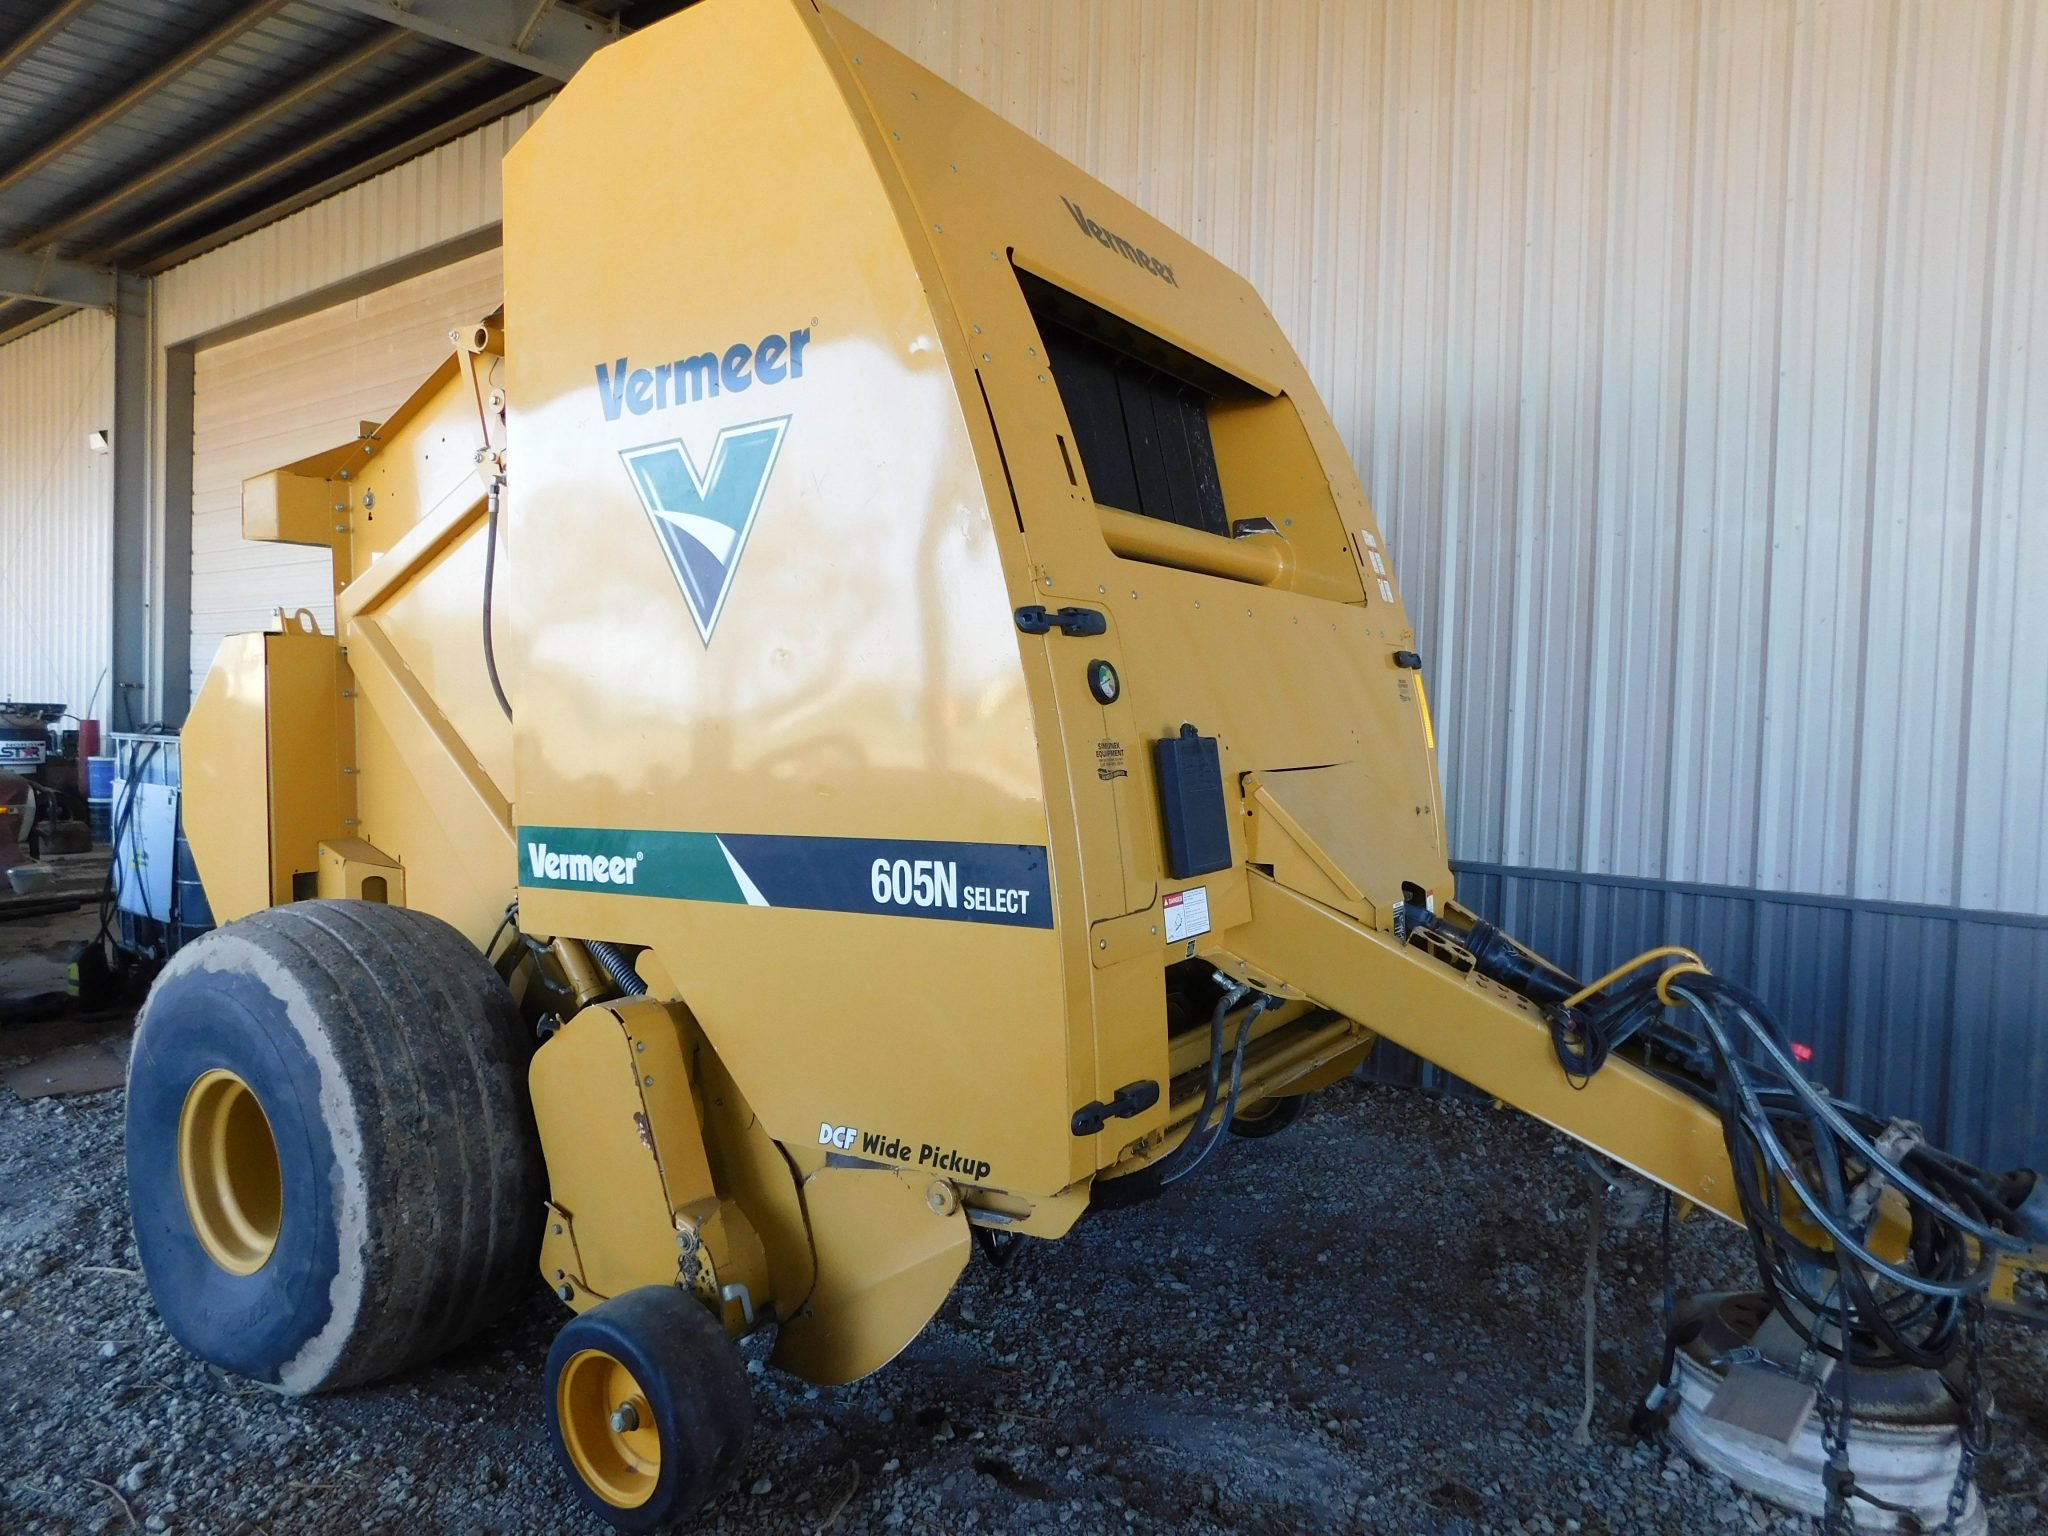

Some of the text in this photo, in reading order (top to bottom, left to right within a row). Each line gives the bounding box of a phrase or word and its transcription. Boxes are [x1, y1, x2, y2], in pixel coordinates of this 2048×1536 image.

[1059, 194, 1180, 289] Vermeer
[594, 327, 811, 422] Vermeer
[1095, 749, 1124, 758] EQUIPMENT
[527, 842, 638, 885] Vermeer
[871, 858, 1030, 915] 605N SELECT
[818, 1121, 991, 1182] DCF Wide Pickup
